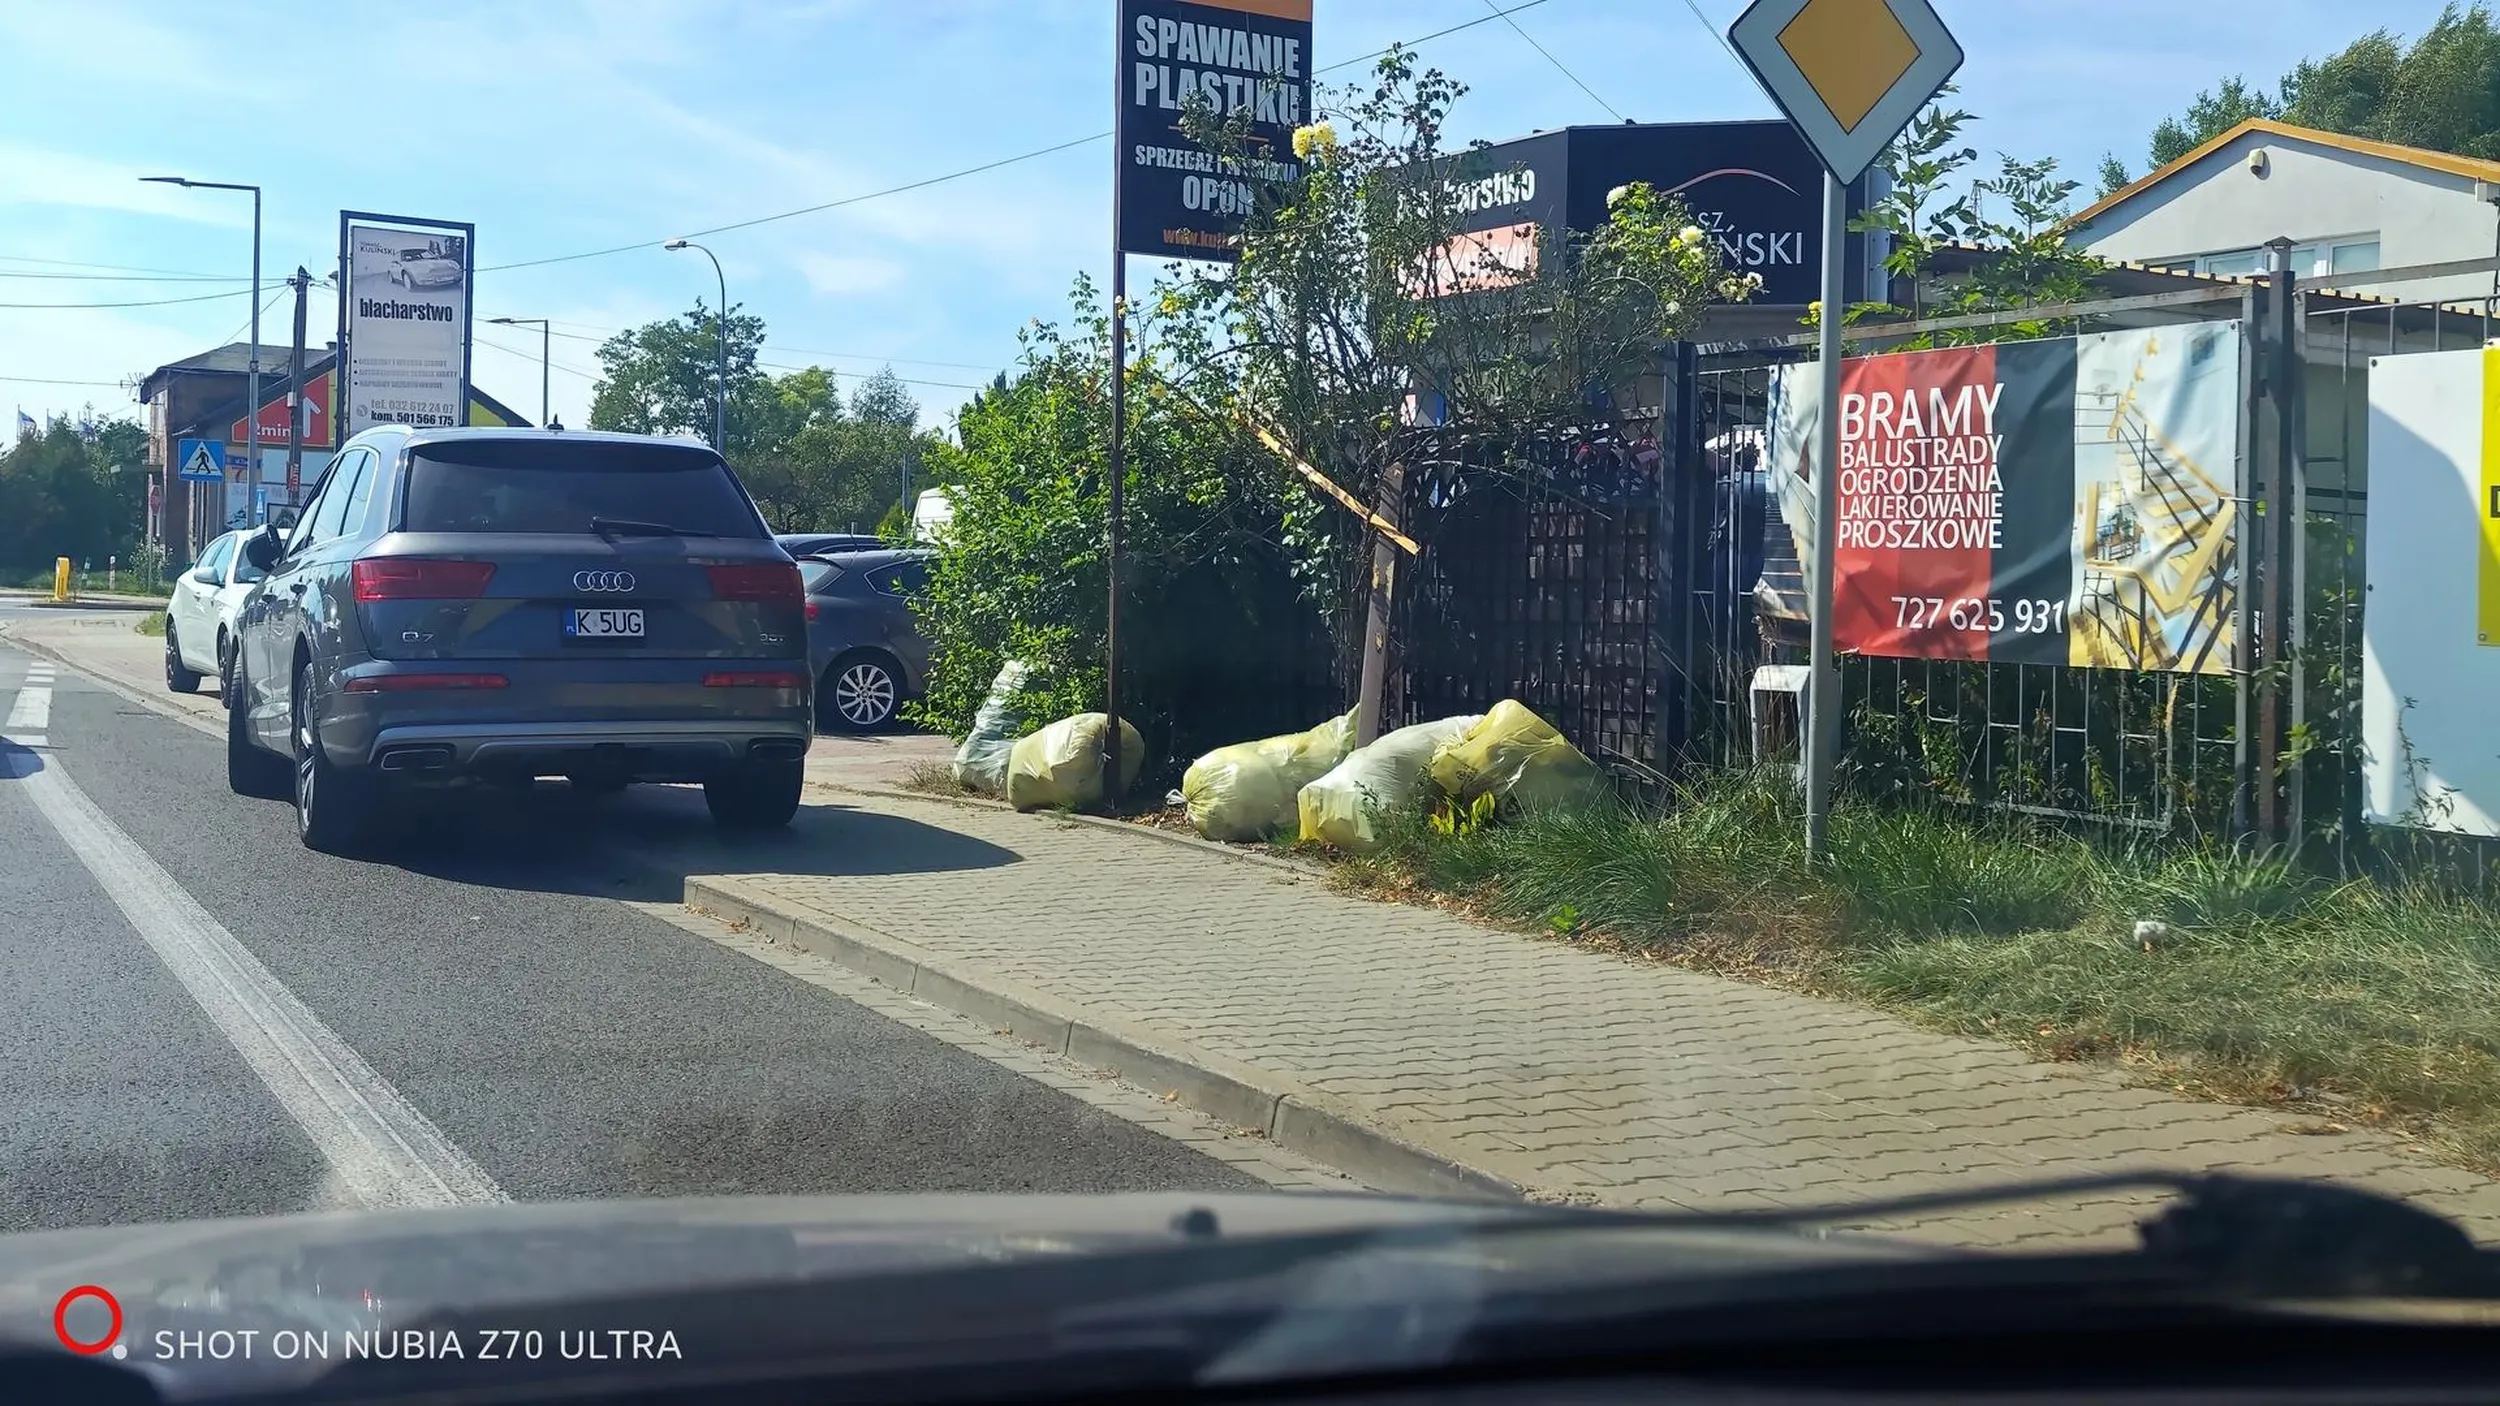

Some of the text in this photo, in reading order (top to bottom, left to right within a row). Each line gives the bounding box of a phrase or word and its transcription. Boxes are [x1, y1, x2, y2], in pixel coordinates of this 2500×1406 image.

[1136, 14, 1300, 78] SPAWANIE
[1135, 62, 1300, 126] PLASTIKU
[1182, 176, 1255, 215] OPON
[360, 298, 453, 322] blacharstwo
[371, 410, 454, 426] kom. 501 566 175
[1840, 383, 2005, 441] BRAMY
[1840, 435, 2003, 469] BALUSTRADY
[1839, 465, 2004, 495] OGRODZENIA
[1840, 493, 2004, 520] LAKIEROWANIE
[1838, 519, 2003, 549] PROSZKOWE
[577, 612, 642, 634] K 5UG
[1891, 597, 2065, 634] 727 625 931
[402, 631, 435, 643] Q7
